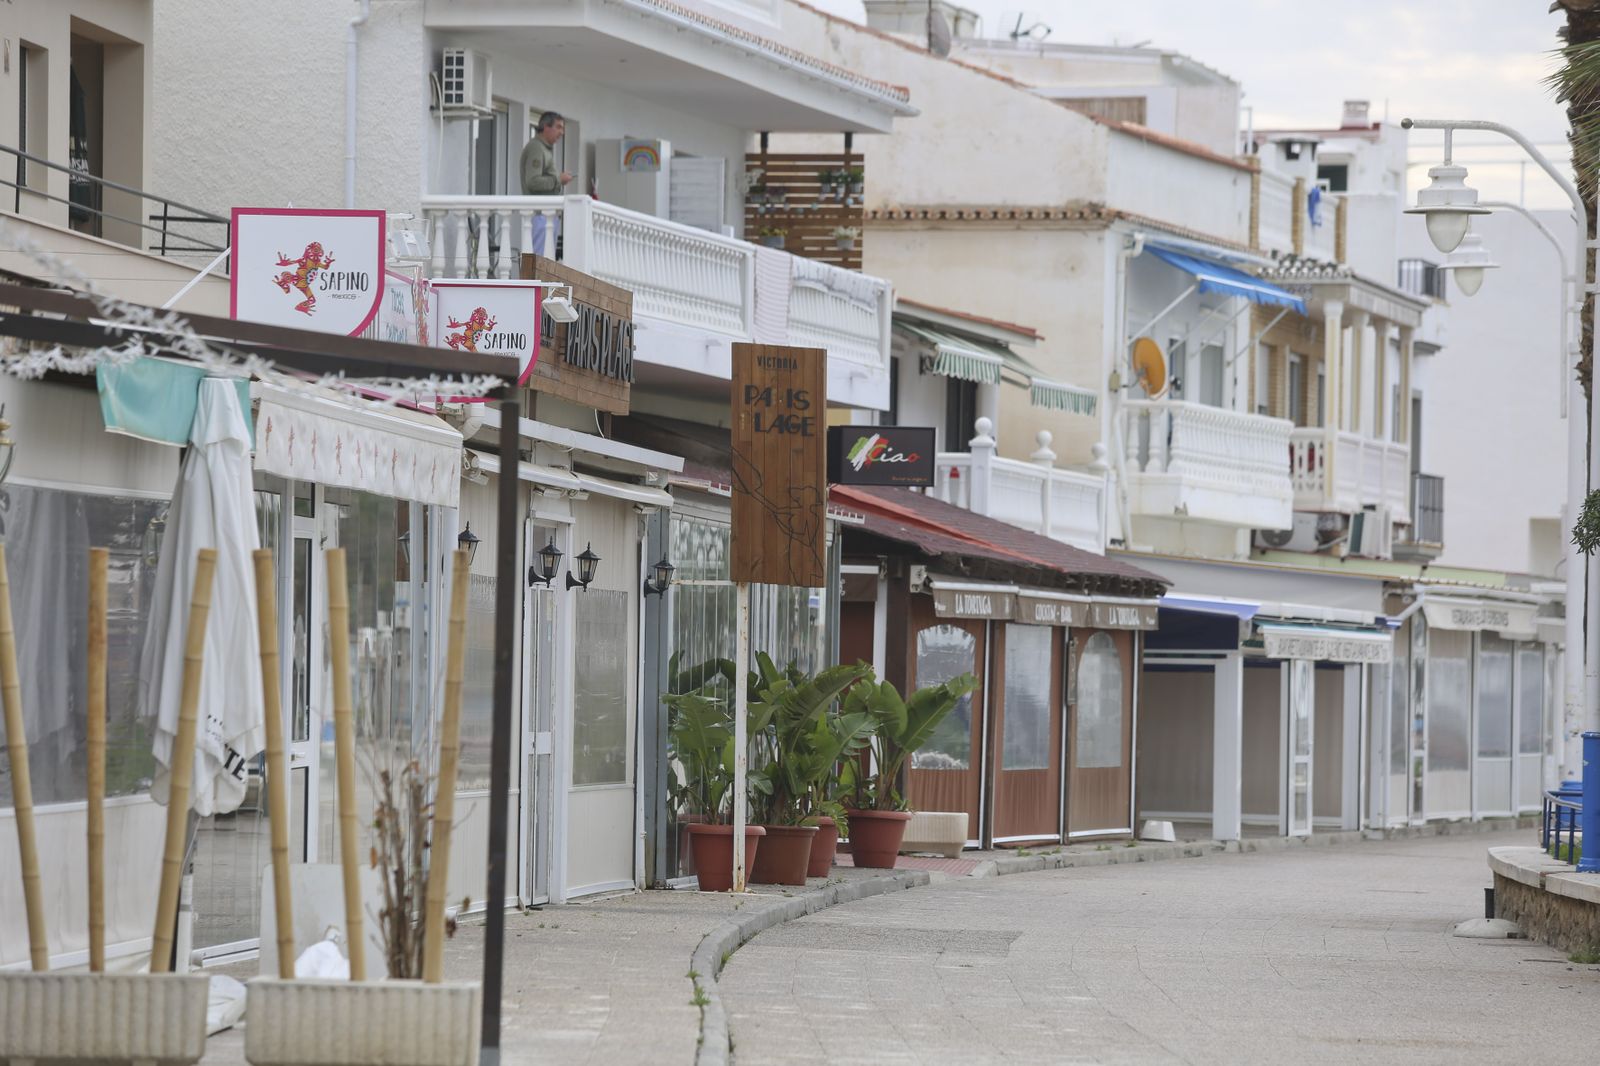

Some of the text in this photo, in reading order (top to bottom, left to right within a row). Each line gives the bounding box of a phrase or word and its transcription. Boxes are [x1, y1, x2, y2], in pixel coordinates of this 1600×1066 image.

[320, 271, 369, 292] SAPINO
[484, 332, 527, 351] SAPINO
[757, 355, 798, 369] VICTORIA
[744, 384, 811, 411] PAIS
[867, 443, 920, 463] Ciao
[955, 592, 964, 614] LA
